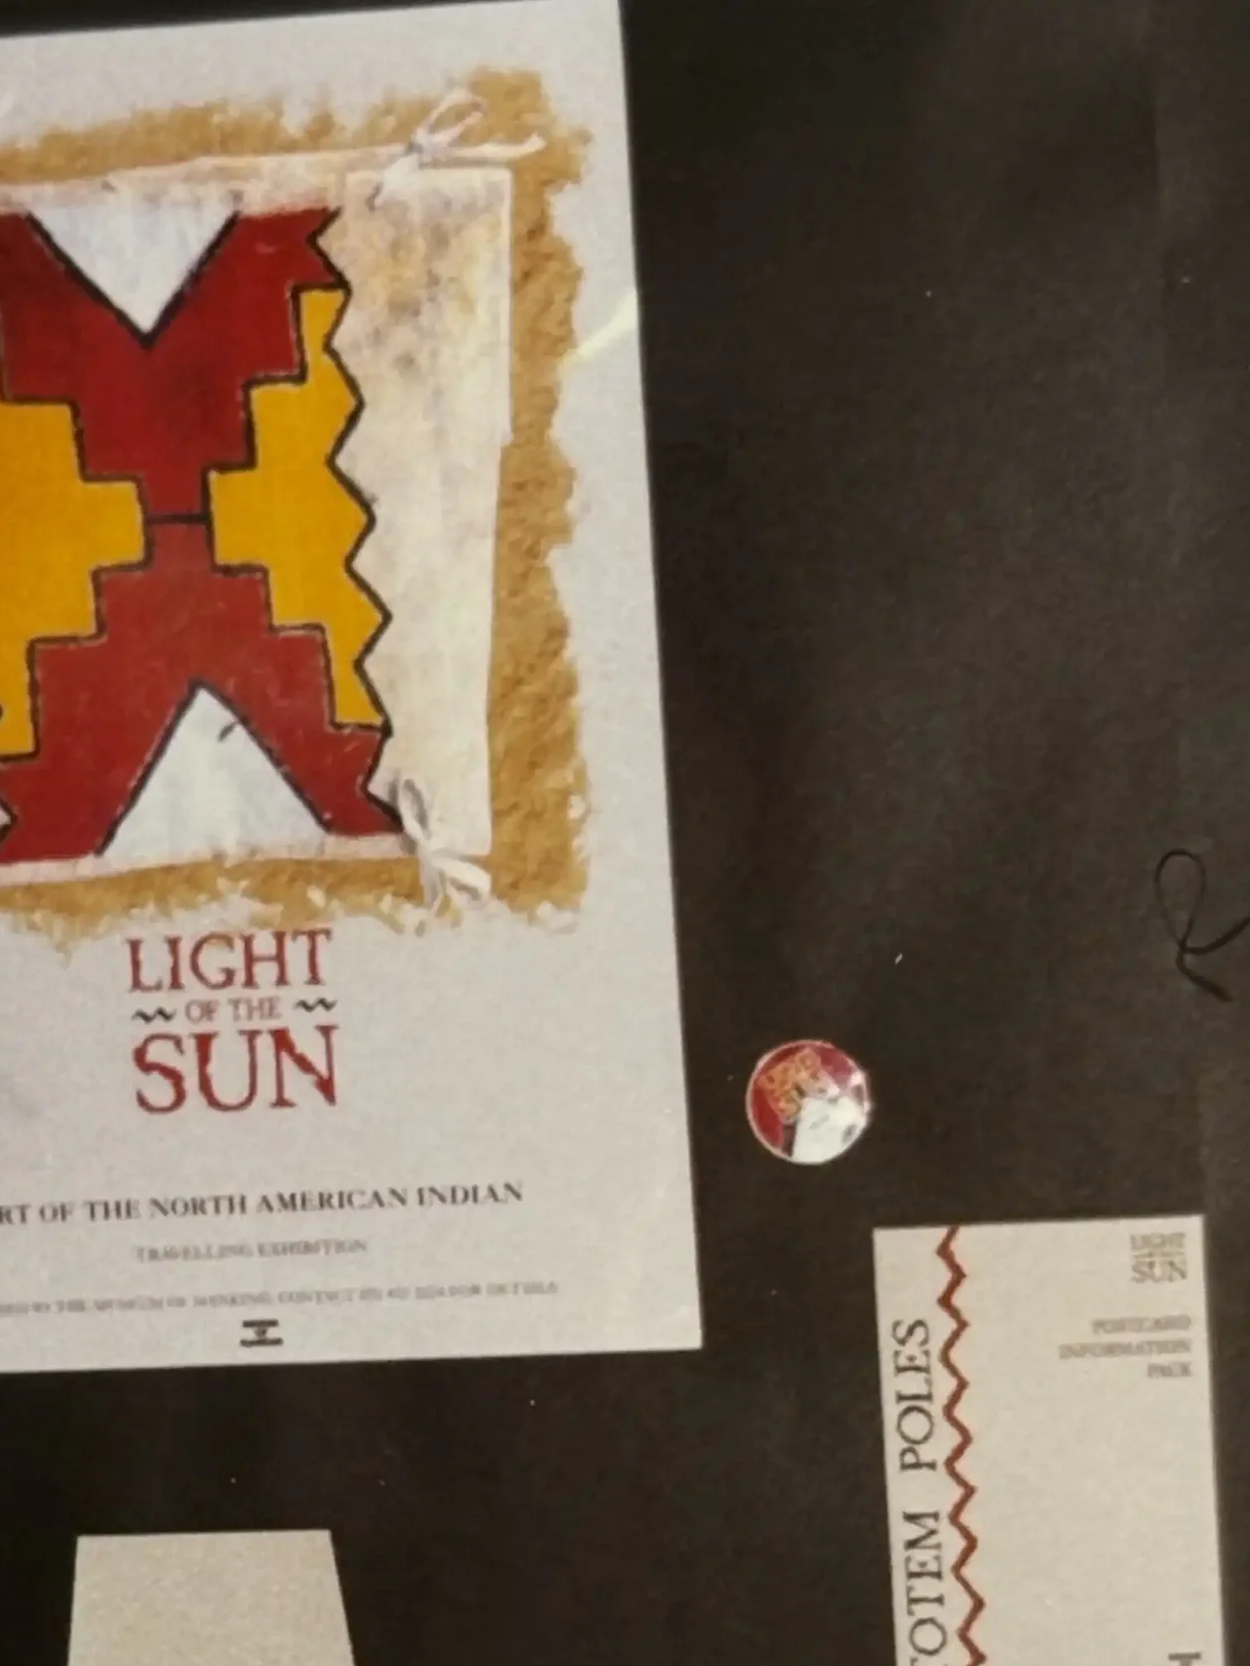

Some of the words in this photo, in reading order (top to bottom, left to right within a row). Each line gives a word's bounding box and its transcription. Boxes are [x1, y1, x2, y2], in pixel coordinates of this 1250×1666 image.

[126, 926, 333, 993] LIGHT
[184, 999, 219, 1023] OF
[227, 996, 283, 1022] THE
[131, 1024, 340, 1114] SUN
[38, 1203, 73, 1224] OF
[82, 1198, 141, 1222] THE
[149, 1193, 248, 1219] NORTH
[256, 1186, 408, 1215] AMERICAN
[416, 1179, 524, 1207] INDIAN
[1130, 1258, 1188, 1284] SUN
[892, 1318, 938, 1472] POLES
